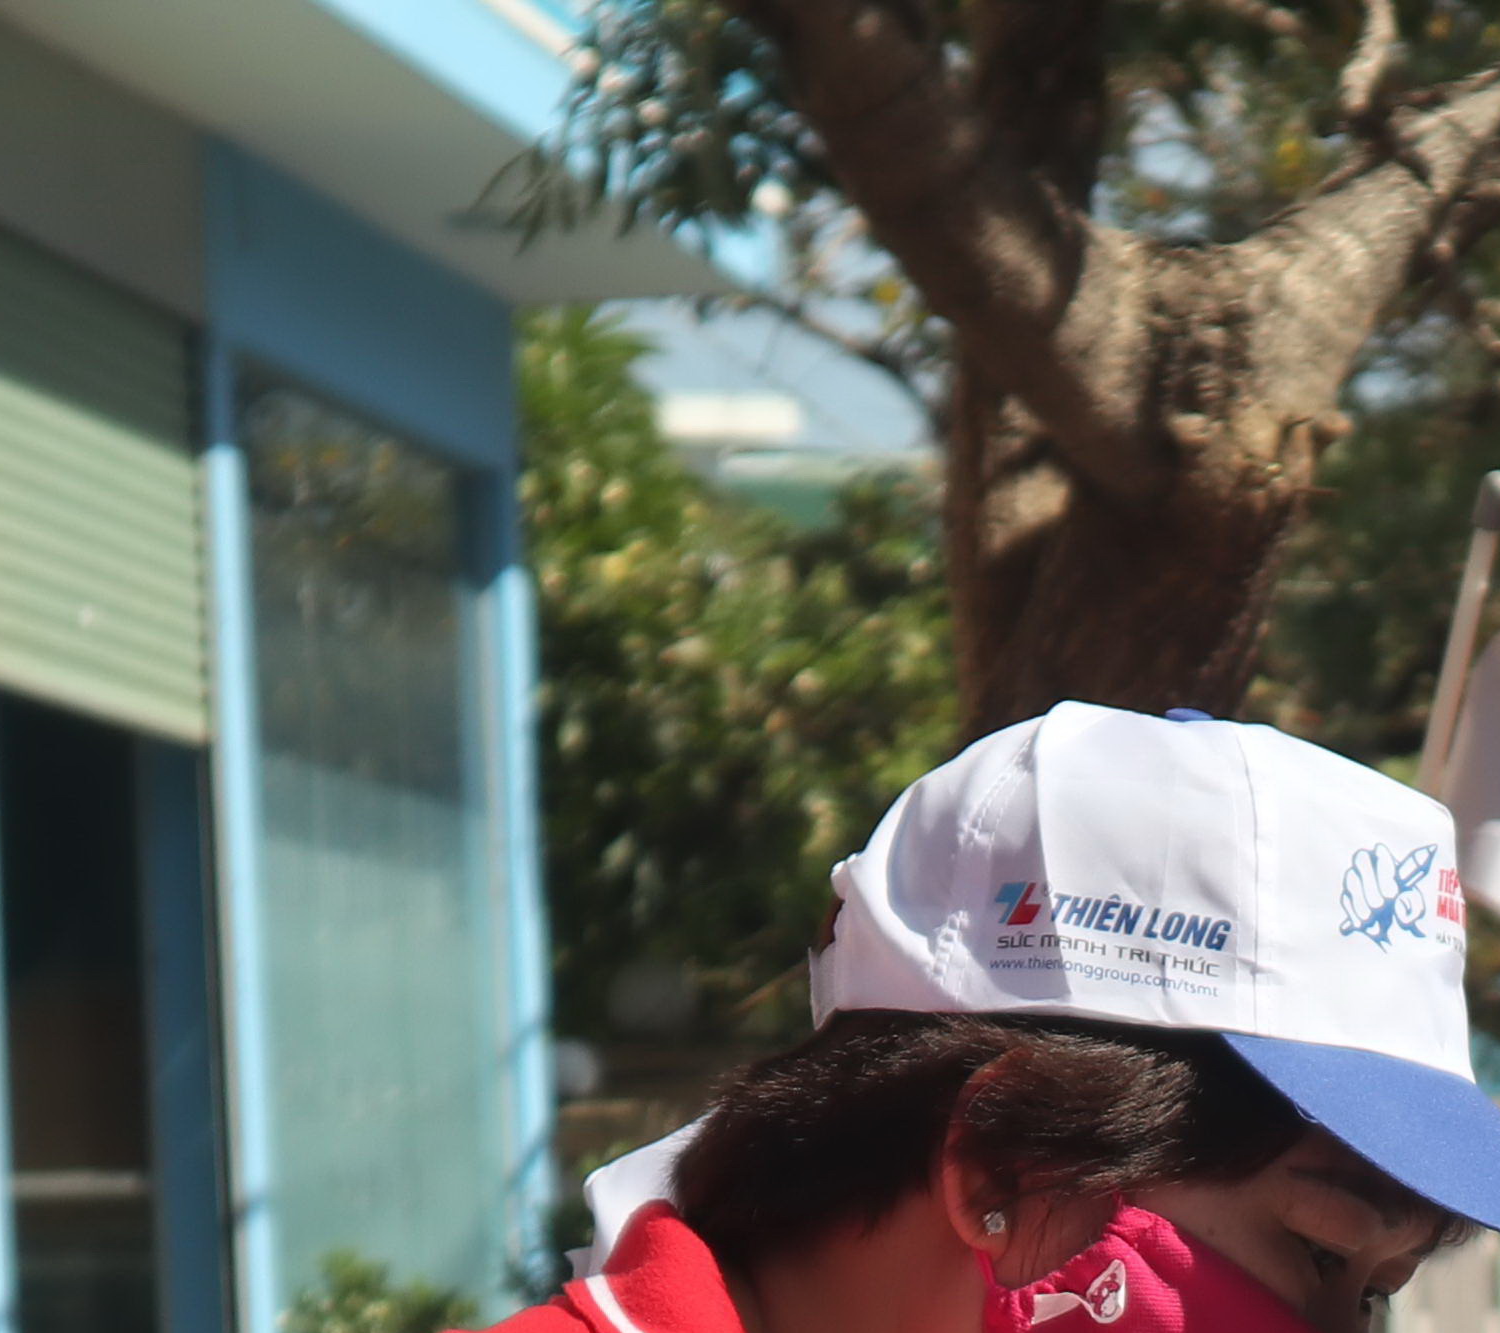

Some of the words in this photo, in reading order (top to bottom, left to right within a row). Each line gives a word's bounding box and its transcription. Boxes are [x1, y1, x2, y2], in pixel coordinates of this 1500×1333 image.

[1051, 892, 1145, 936] THIÊN
[1143, 907, 1232, 951] LONG
[989, 955, 1219, 997] www.thienlonggroup.com/tsmt
[996, 931, 1037, 949] SỨC
[1040, 934, 1107, 956] MẠNH
[1114, 944, 1150, 963] TRI
[1155, 952, 1221, 978] THỨC
